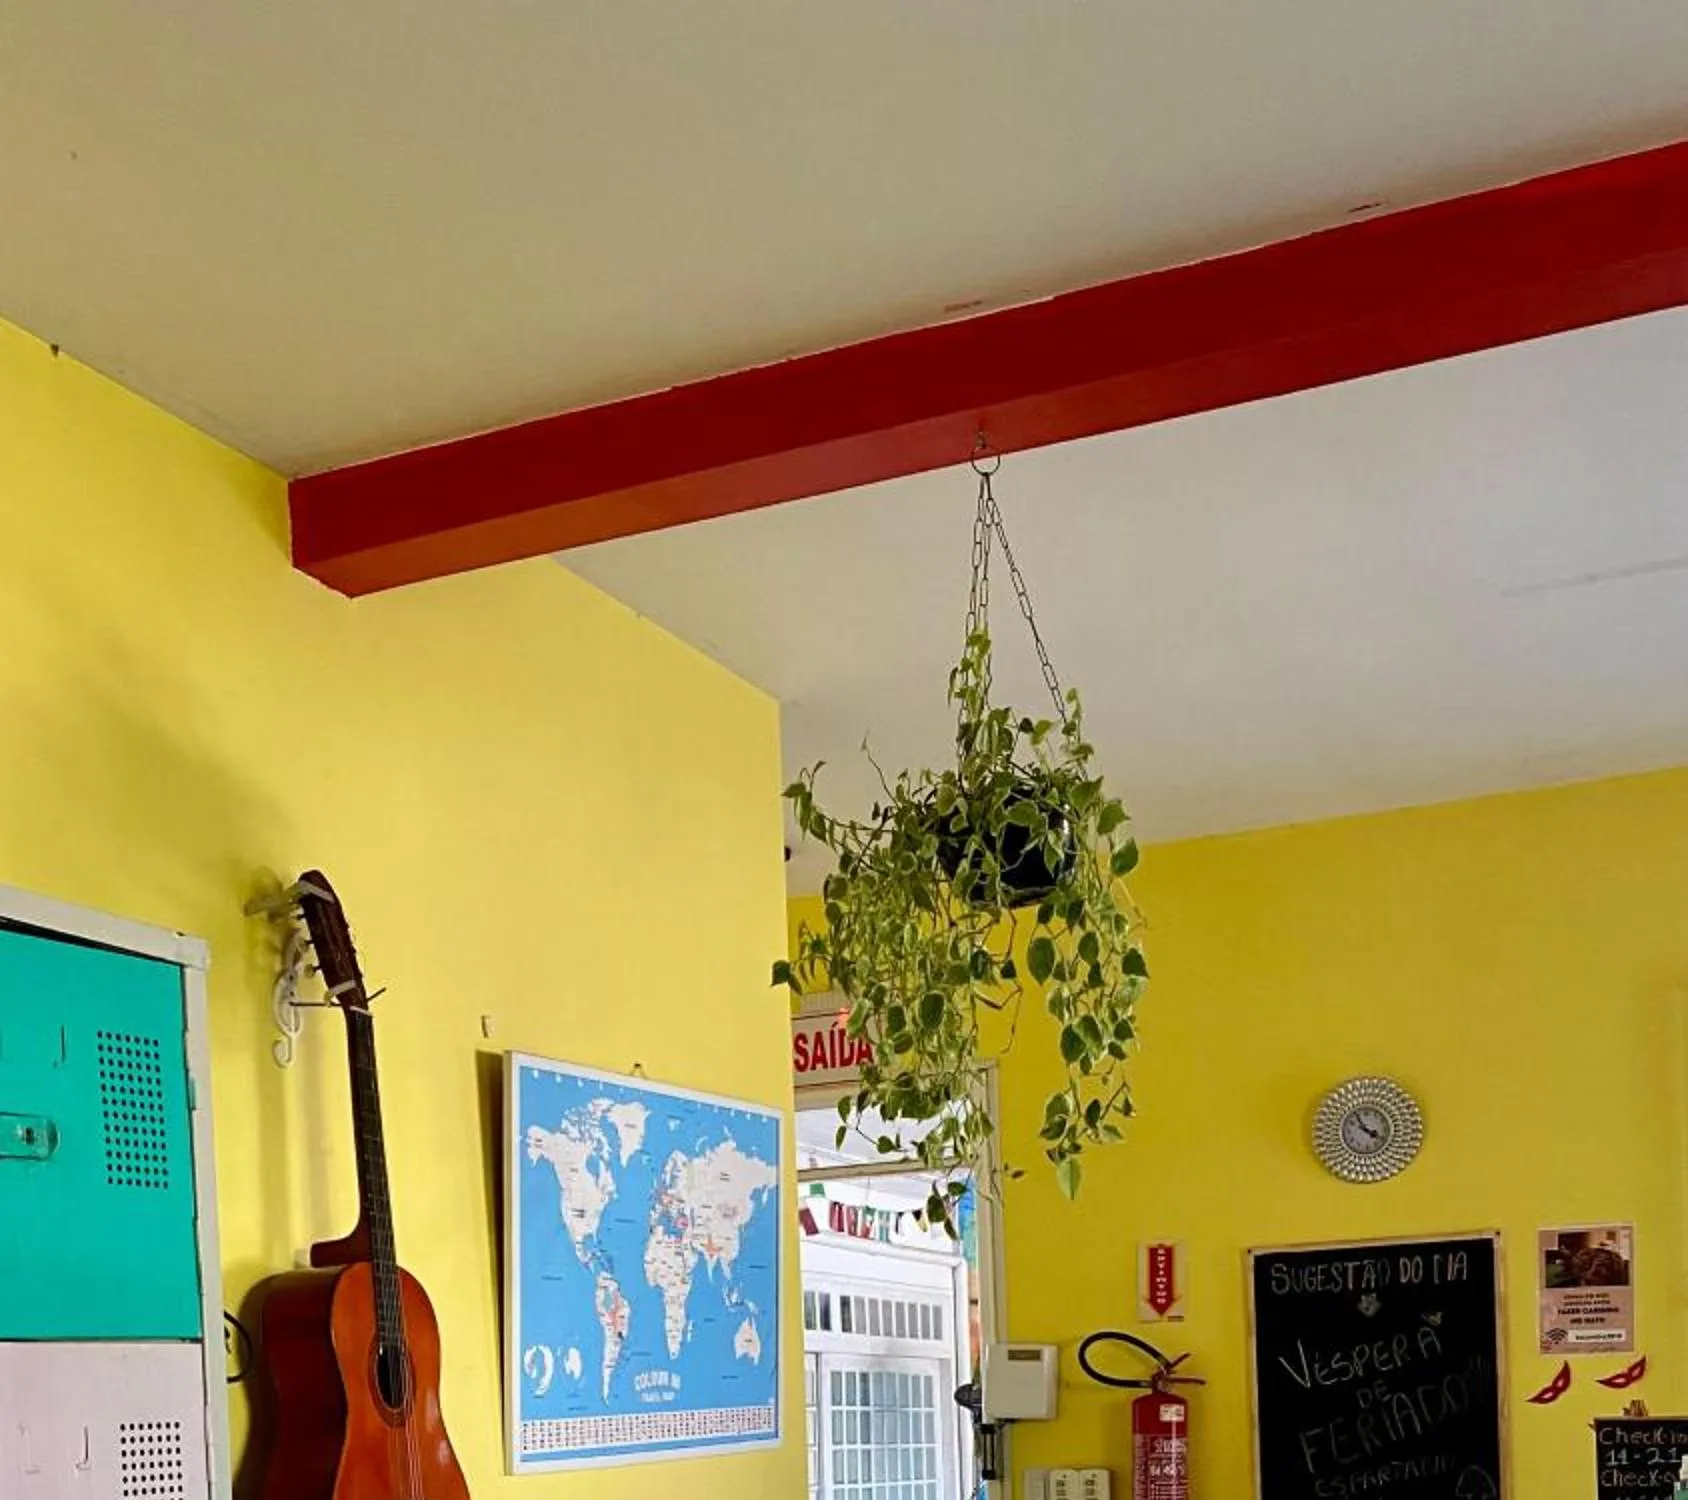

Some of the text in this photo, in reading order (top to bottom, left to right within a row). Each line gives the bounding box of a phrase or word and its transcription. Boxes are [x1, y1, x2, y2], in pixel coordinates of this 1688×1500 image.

[793, 1021, 874, 1072] SAÍDA
[1398, 1254, 1424, 1285] DO
[1356, 1379, 1393, 1408] DE
